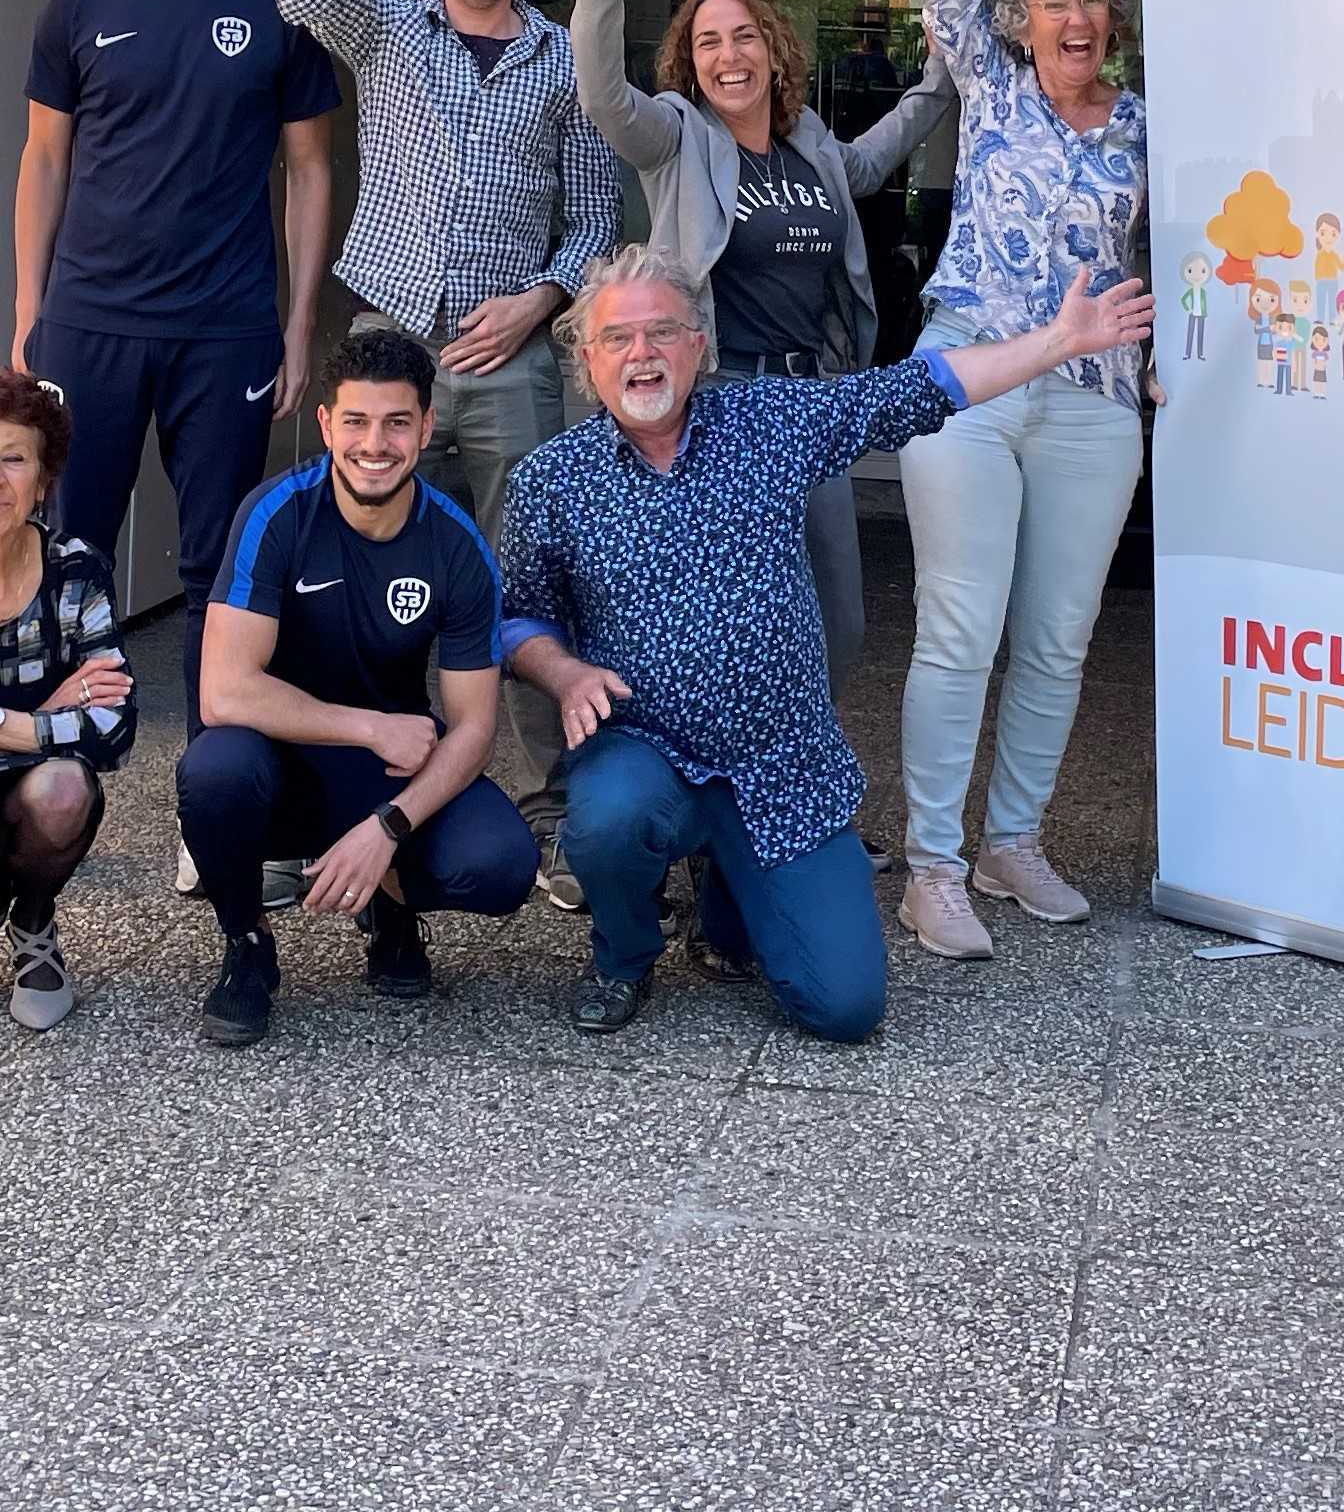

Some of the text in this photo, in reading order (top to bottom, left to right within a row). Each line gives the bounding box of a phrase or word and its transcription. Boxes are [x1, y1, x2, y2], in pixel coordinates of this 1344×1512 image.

[788, 226, 820, 237] DENIM
[775, 242, 805, 253] SINCE
[395, 591, 421, 607] SB
